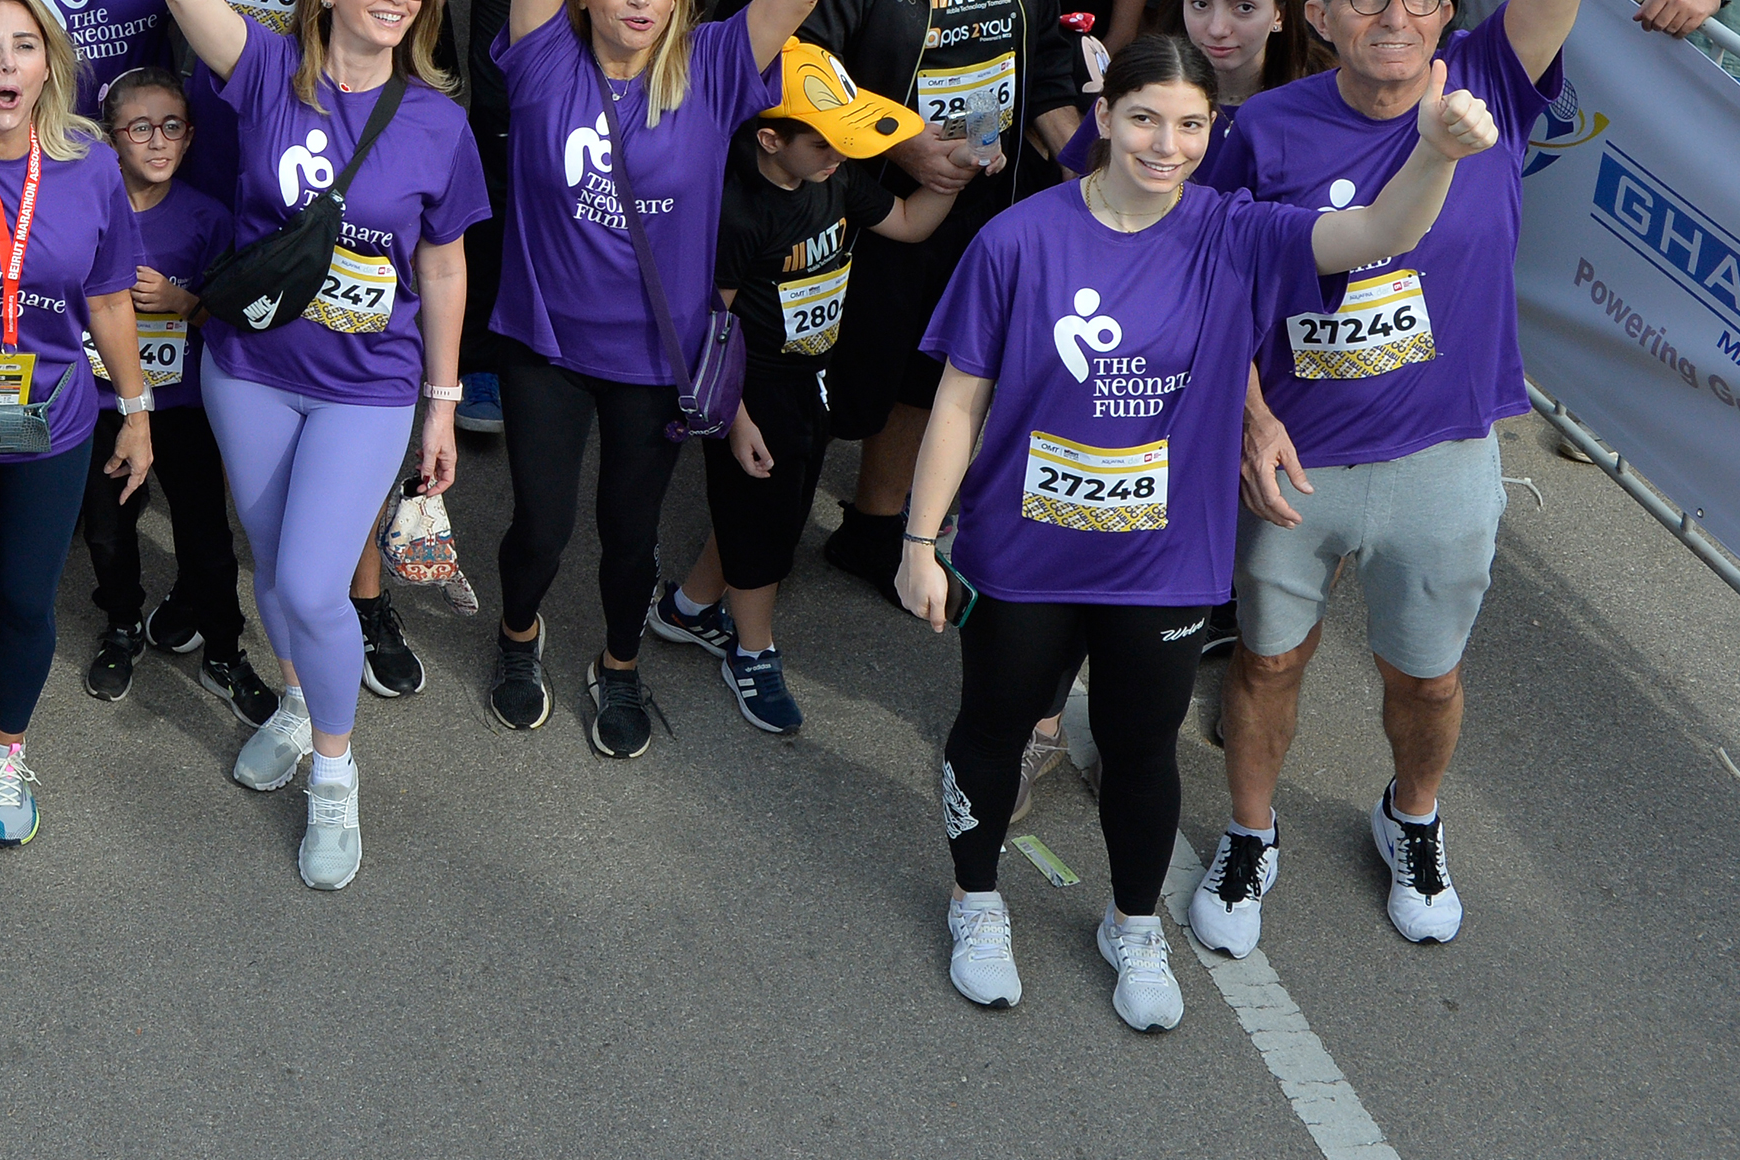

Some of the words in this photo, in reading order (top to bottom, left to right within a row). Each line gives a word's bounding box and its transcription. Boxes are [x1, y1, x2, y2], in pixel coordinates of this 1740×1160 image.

[926, 24, 970, 50] apps
[927, 79, 945, 88] OMT
[16, 182, 36, 241] MARATHON
[8, 242, 25, 281] BEIRUT
[242, 294, 276, 322] NIKE
[789, 290, 806, 299] OMT
[1298, 304, 1418, 345] 27246
[1573, 256, 1700, 389] Powering
[1041, 443, 1059, 455] OMT
[1037, 466, 1156, 503] 27248
